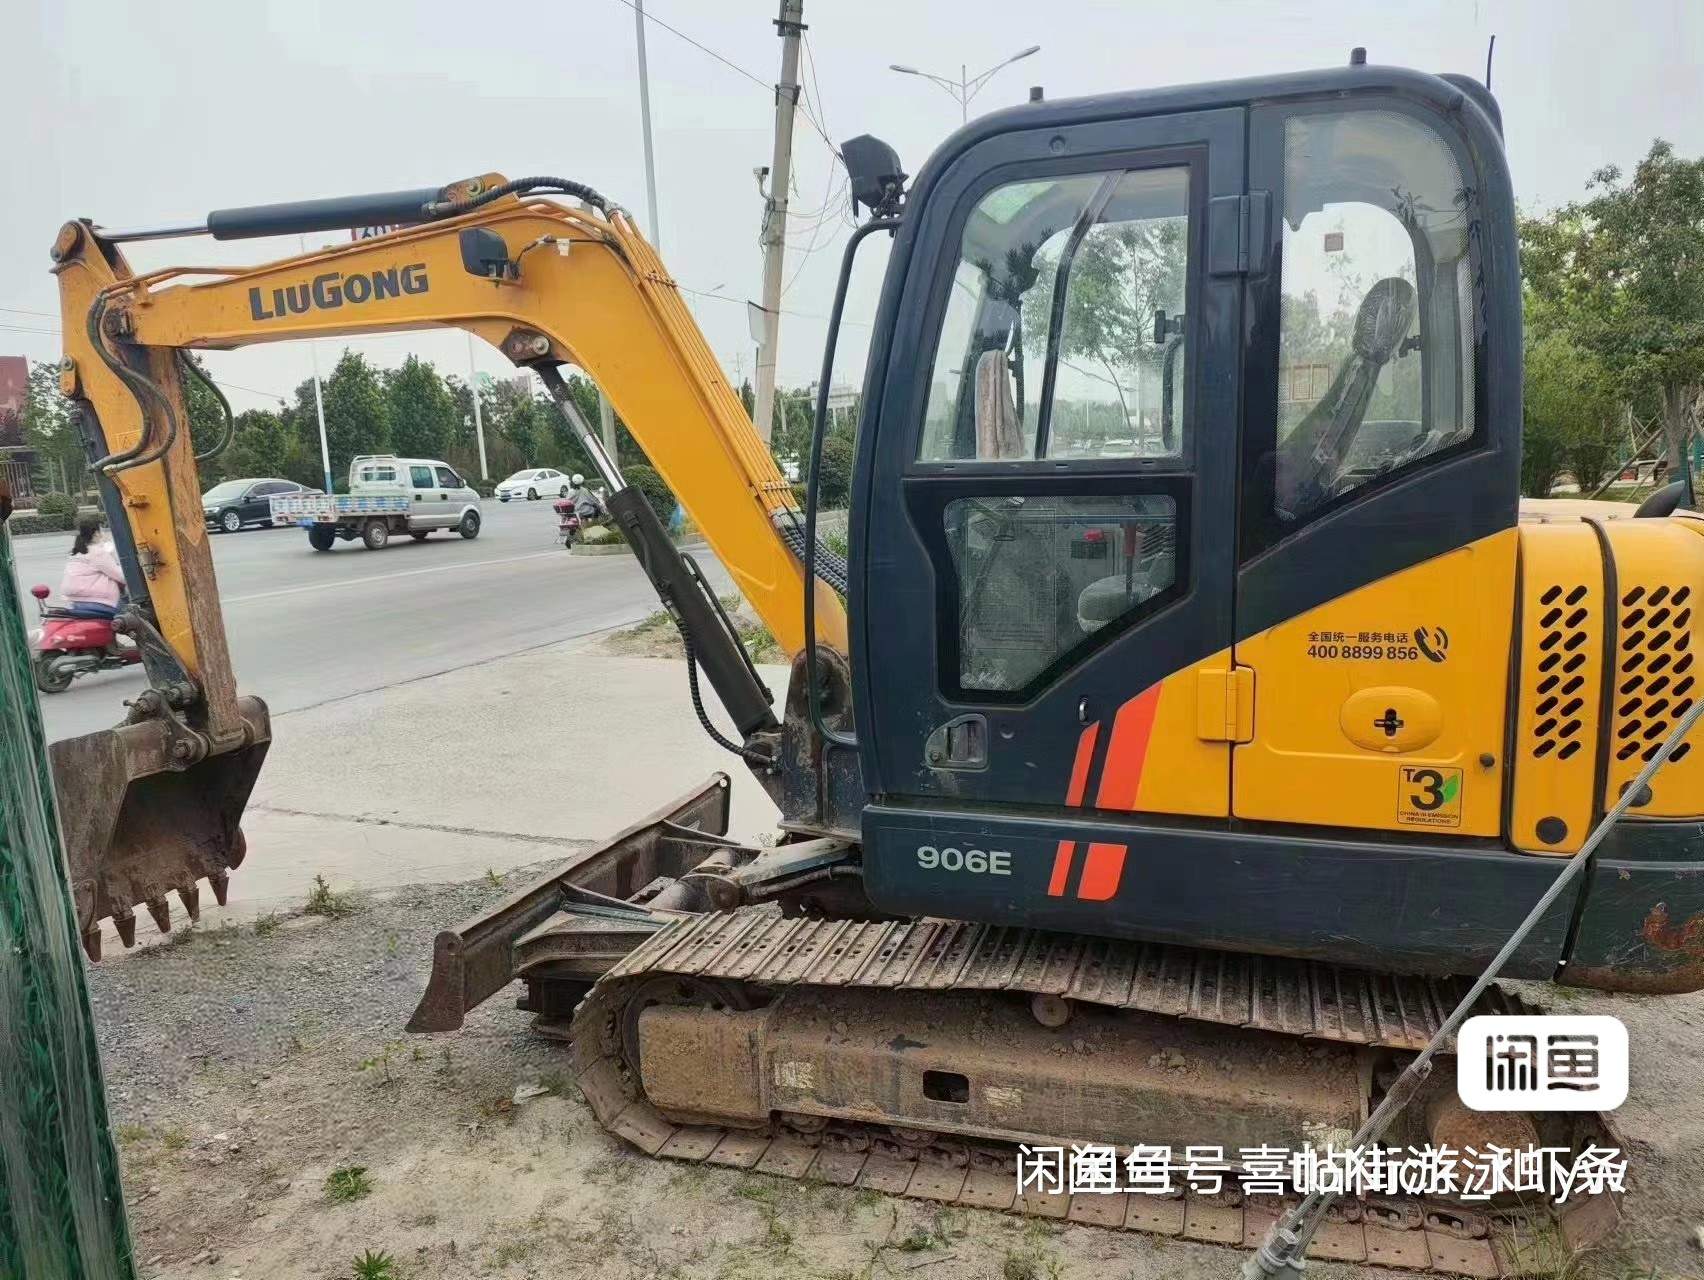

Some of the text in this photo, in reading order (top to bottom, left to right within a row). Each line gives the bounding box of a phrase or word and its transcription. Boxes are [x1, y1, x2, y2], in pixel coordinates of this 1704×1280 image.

[1307, 632, 1408, 643] 全国统一服务电话
[1307, 645, 1418, 660] 400 8899 856
[917, 846, 1012, 875] 906E
